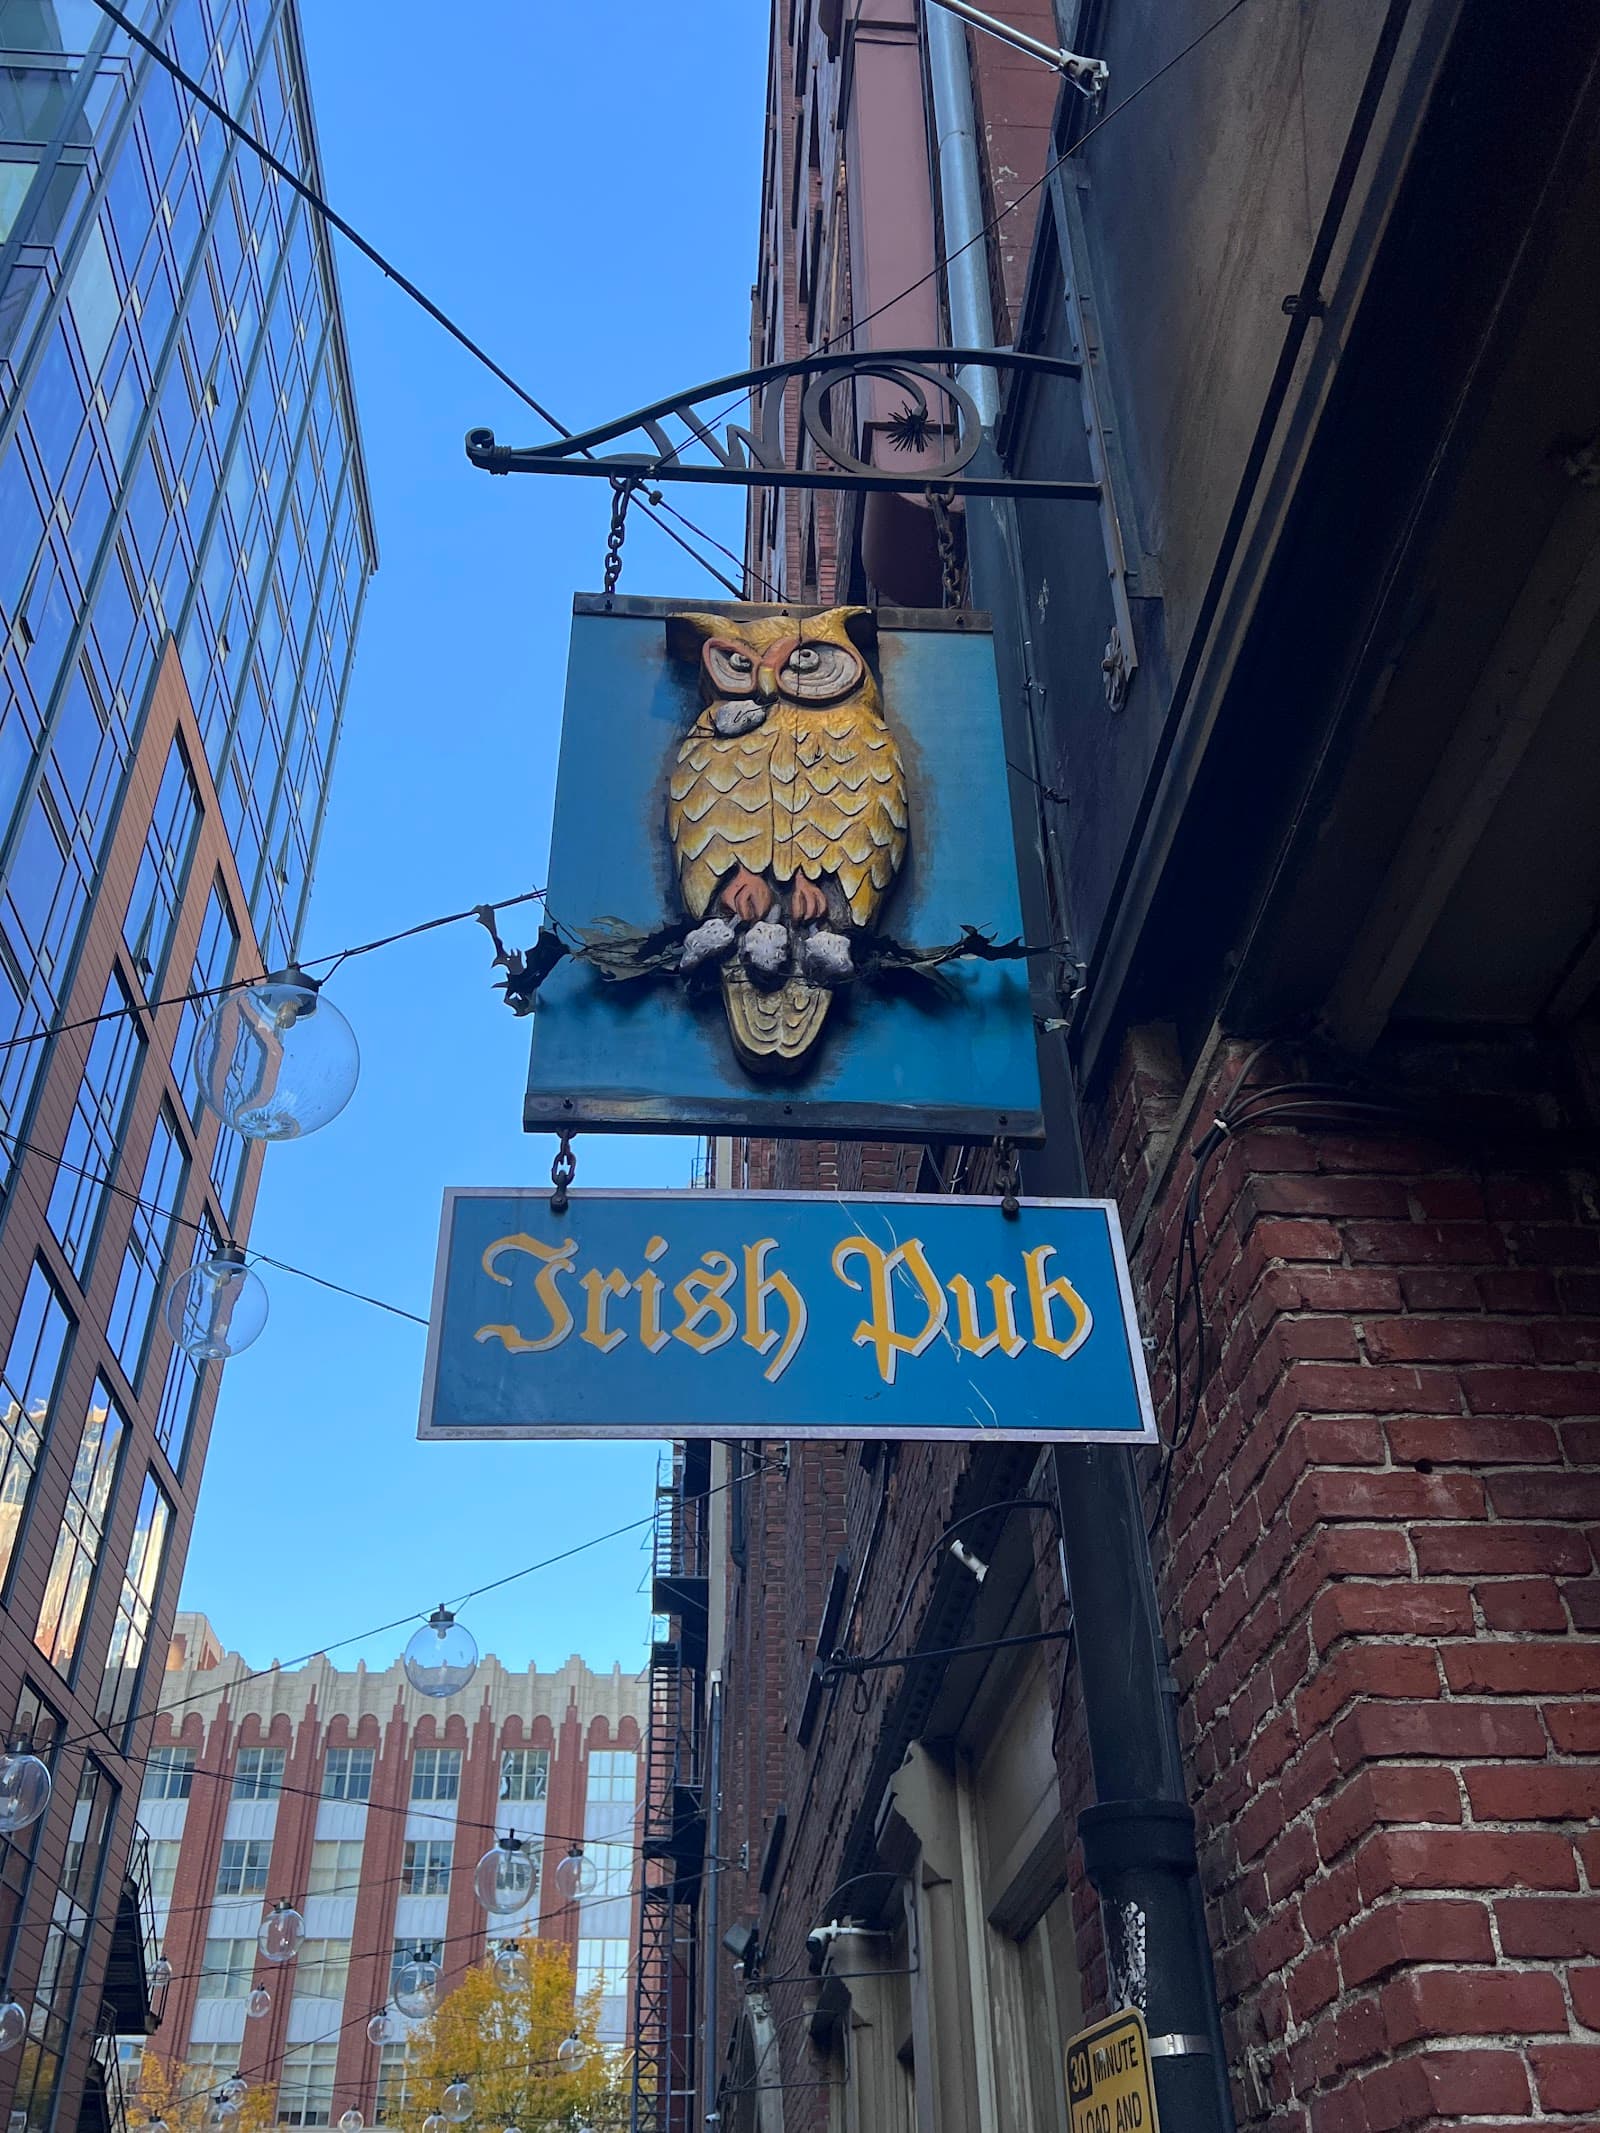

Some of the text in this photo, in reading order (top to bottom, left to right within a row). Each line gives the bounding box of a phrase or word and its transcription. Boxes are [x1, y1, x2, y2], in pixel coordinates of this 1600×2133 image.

[474, 1231, 1094, 1385] Irish Pub
[1070, 2035, 1139, 2093] 30 MINUTE
[1116, 2091, 1142, 2133] AND
